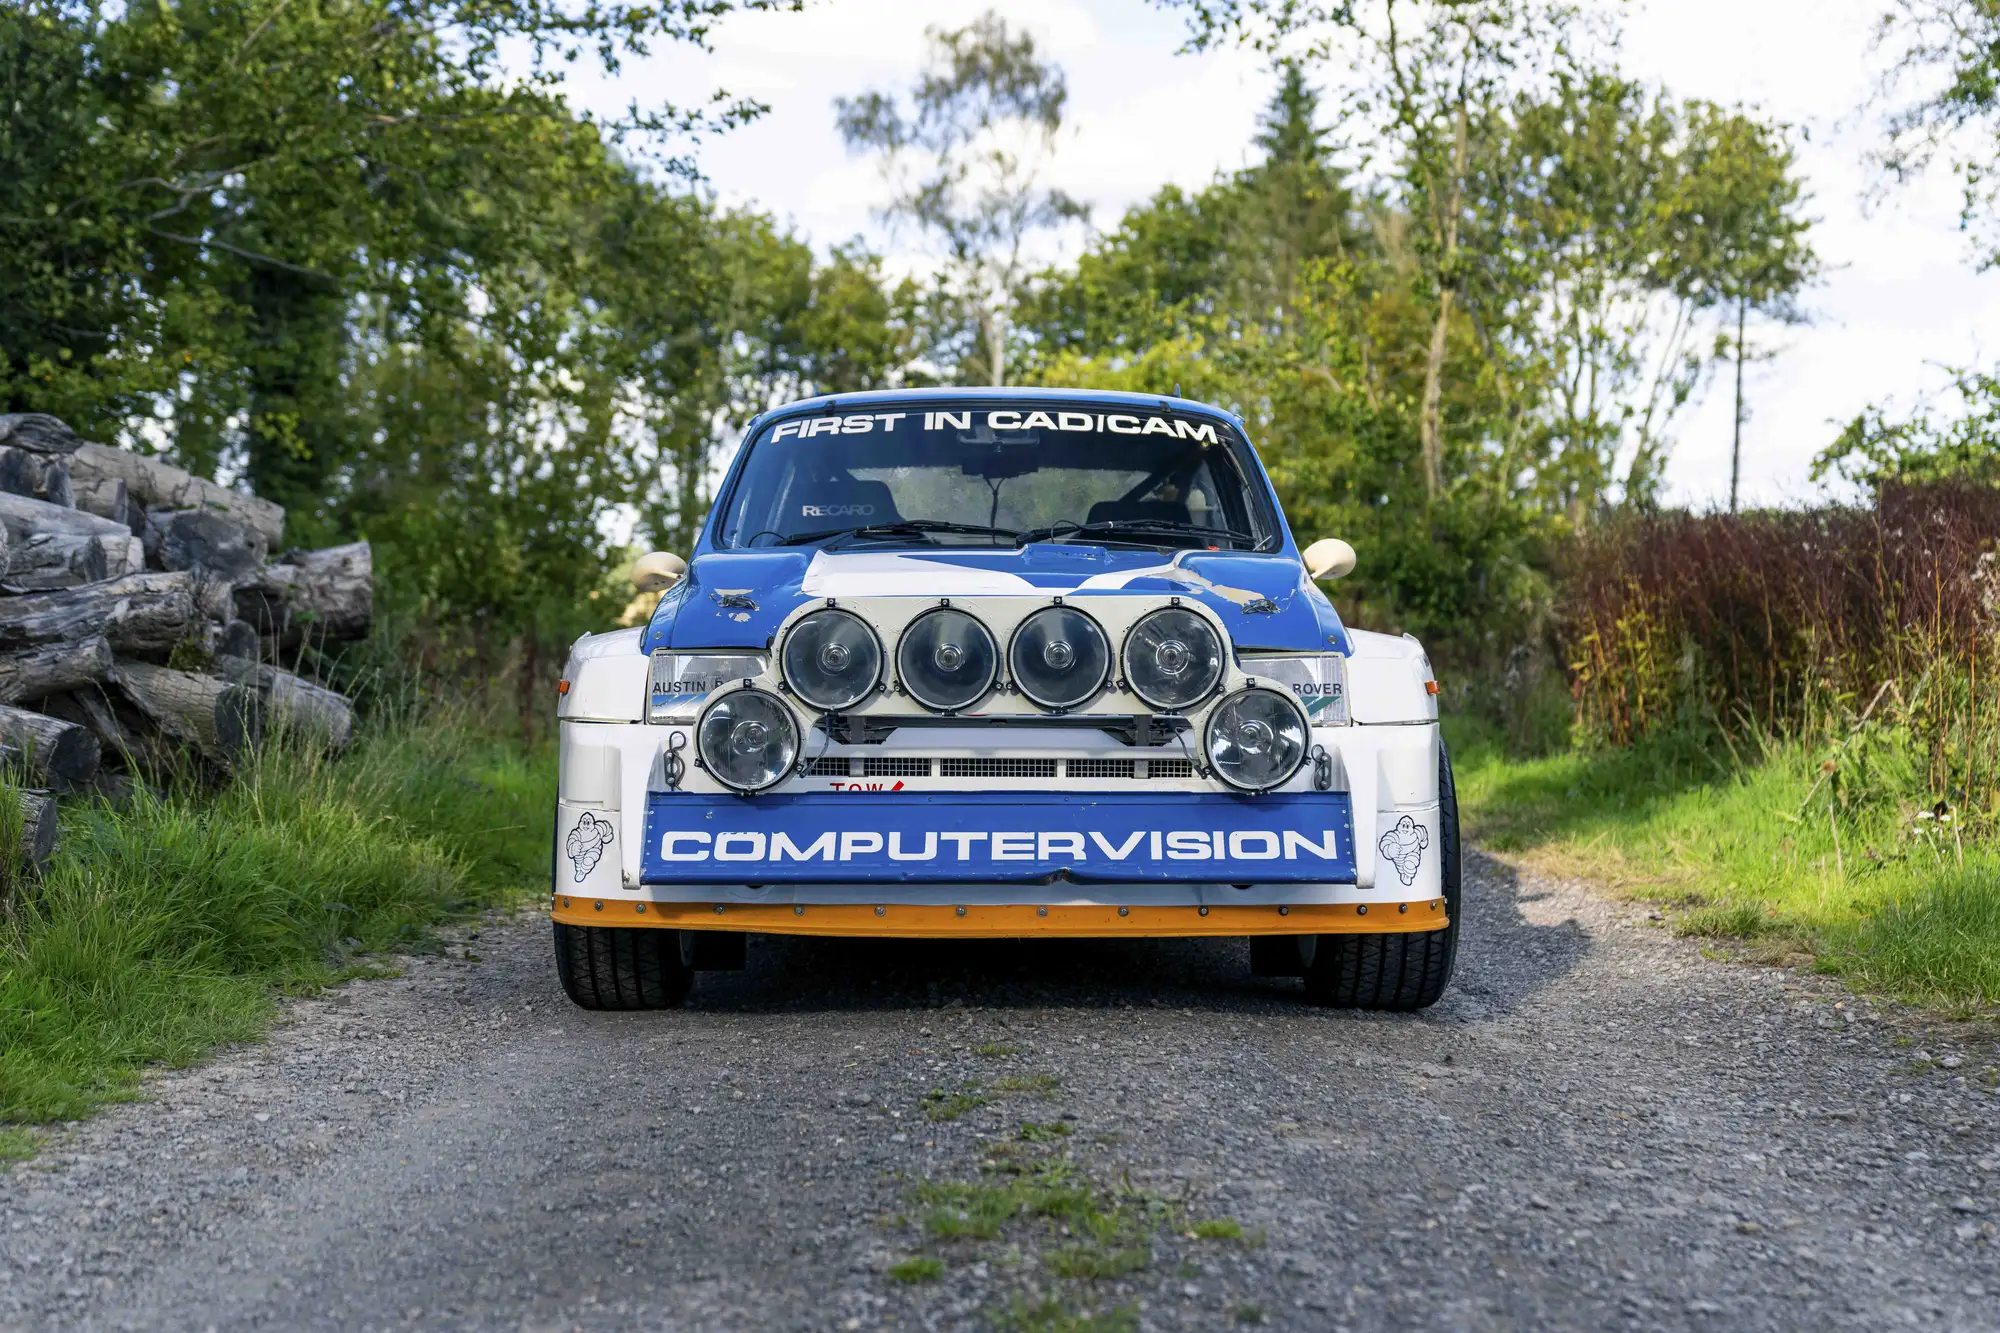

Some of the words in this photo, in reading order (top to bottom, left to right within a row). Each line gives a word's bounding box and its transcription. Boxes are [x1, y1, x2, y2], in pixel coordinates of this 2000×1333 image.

[770, 412, 906, 444] FIRST
[924, 411, 971, 430] IN
[802, 504, 875, 516] RECARO
[652, 680, 706, 693] AUSTIN
[1292, 683, 1342, 695] ROVER
[660, 831, 1337, 861] COMPUTERVISION
